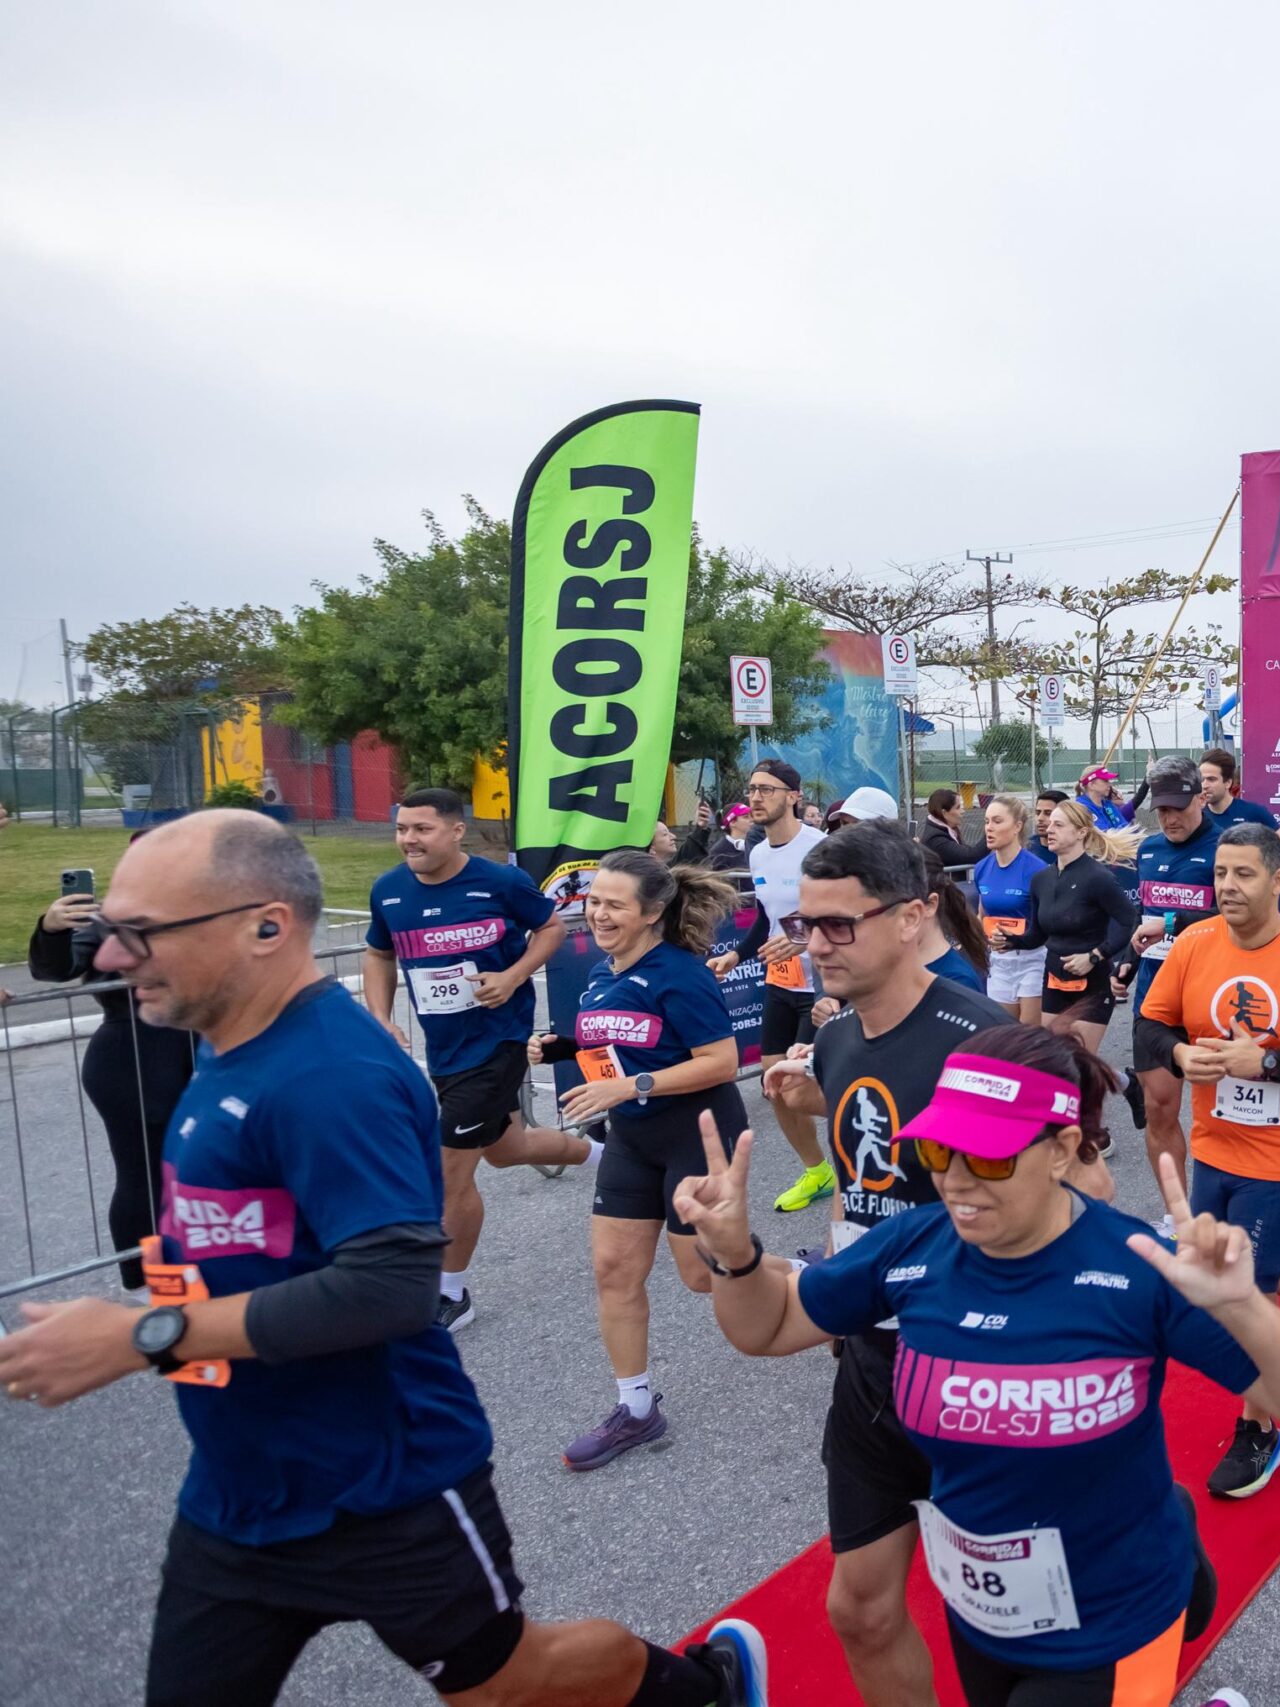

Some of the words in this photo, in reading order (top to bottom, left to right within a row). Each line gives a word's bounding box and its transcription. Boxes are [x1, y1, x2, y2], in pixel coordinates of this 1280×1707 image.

[548, 464, 656, 823] ACORSJ
[894, 643, 903, 658] E
[745, 668, 757, 690] E
[1049, 683, 1056, 695] E
[1152, 886, 1204, 900] CORRIDA
[423, 922, 497, 944] CORRIDA
[427, 940, 462, 953] CDL-SJ
[464, 933, 497, 948] 2025
[430, 984, 459, 998] 298
[728, 1003, 763, 1017] NIZAÇÃO
[581, 1015, 651, 1033] CORRIDA
[731, 1016, 763, 1031] CORSJ
[607, 1029, 648, 1042] 2025
[600, 1064, 616, 1079] 487
[965, 1075, 1012, 1092] CORRIDA
[1233, 1084, 1264, 1105] 341
[1233, 1105, 1263, 1115] MAYCON
[173, 1195, 263, 1231] RIDA
[1074, 1275, 1130, 1290] IMPERATRIZ
[984, 1315, 1009, 1325] CDL
[940, 1364, 1135, 1412] CORRIDA
[938, 1407, 1042, 1436] CDL-SJ
[1049, 1395, 1135, 1435] 2025
[961, 1562, 1006, 1597] 88
